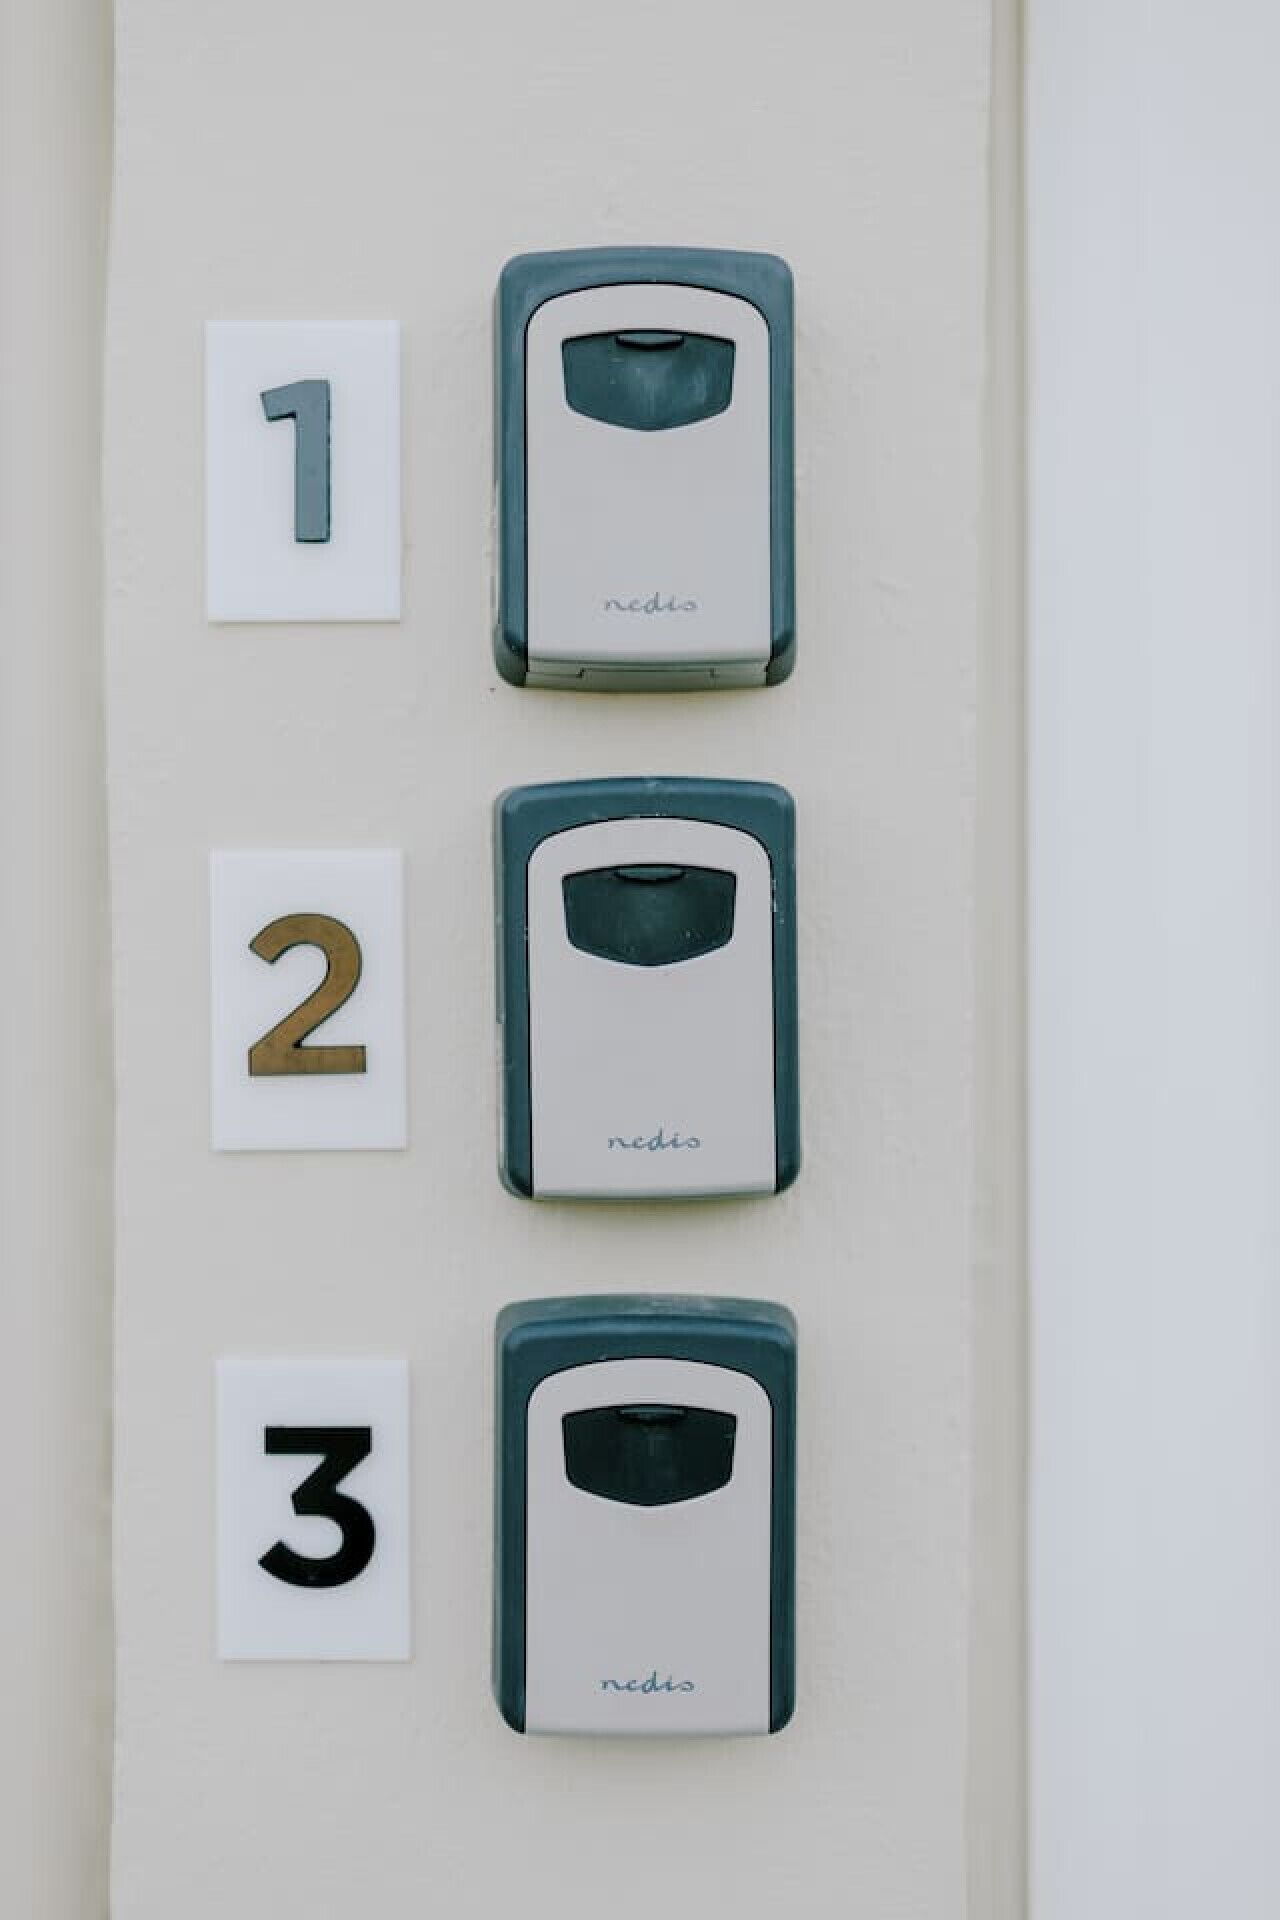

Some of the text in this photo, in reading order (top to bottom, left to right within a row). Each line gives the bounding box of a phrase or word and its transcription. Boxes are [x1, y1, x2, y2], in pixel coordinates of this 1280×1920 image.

[259, 378, 332, 544] 1
[247, 911, 368, 1078] 2
[607, 1128, 701, 1153] nedis
[257, 1424, 377, 1590] 3
[600, 1669, 696, 1694] nedis
